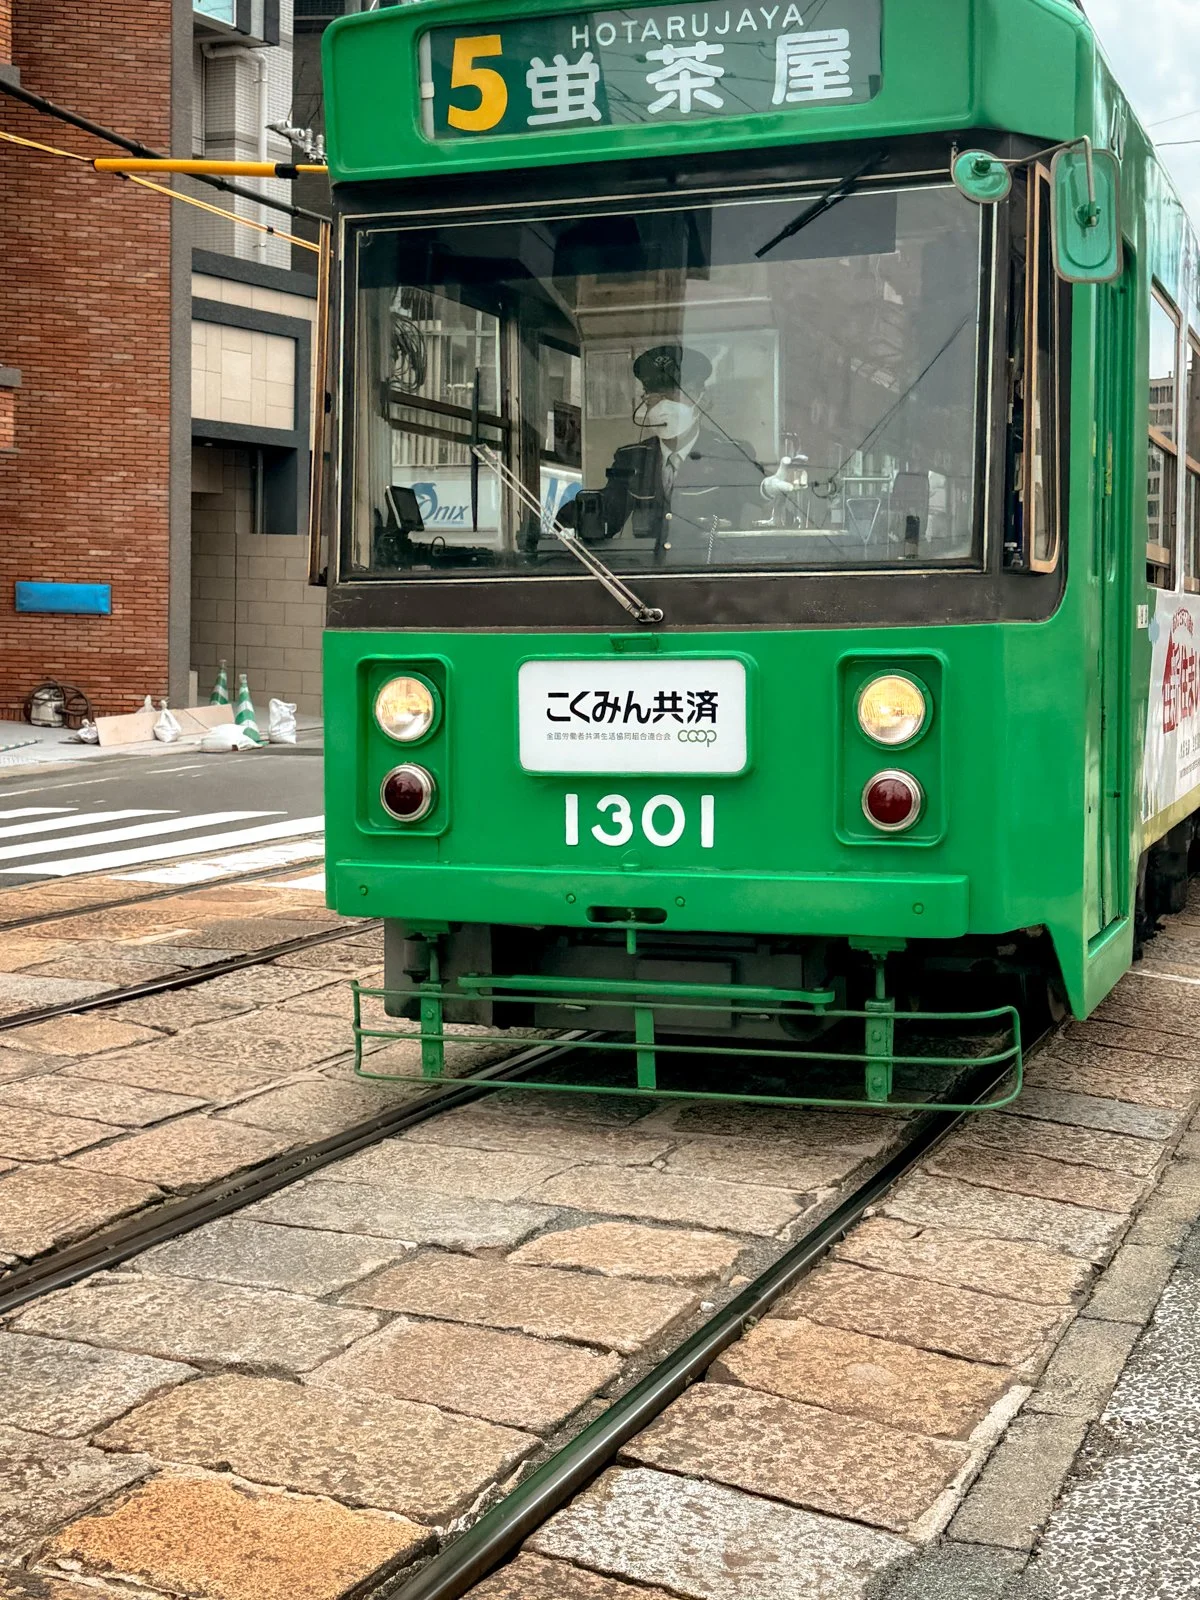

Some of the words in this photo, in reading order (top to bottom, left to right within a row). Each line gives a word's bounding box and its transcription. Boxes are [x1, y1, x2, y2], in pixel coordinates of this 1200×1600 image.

[571, 3, 804, 49] HOTARUJAYA
[447, 33, 508, 133] 5
[526, 28, 853, 127] 蛍茶屋
[546, 690, 719, 724] こくみん共済
[565, 793, 715, 849] 1301
